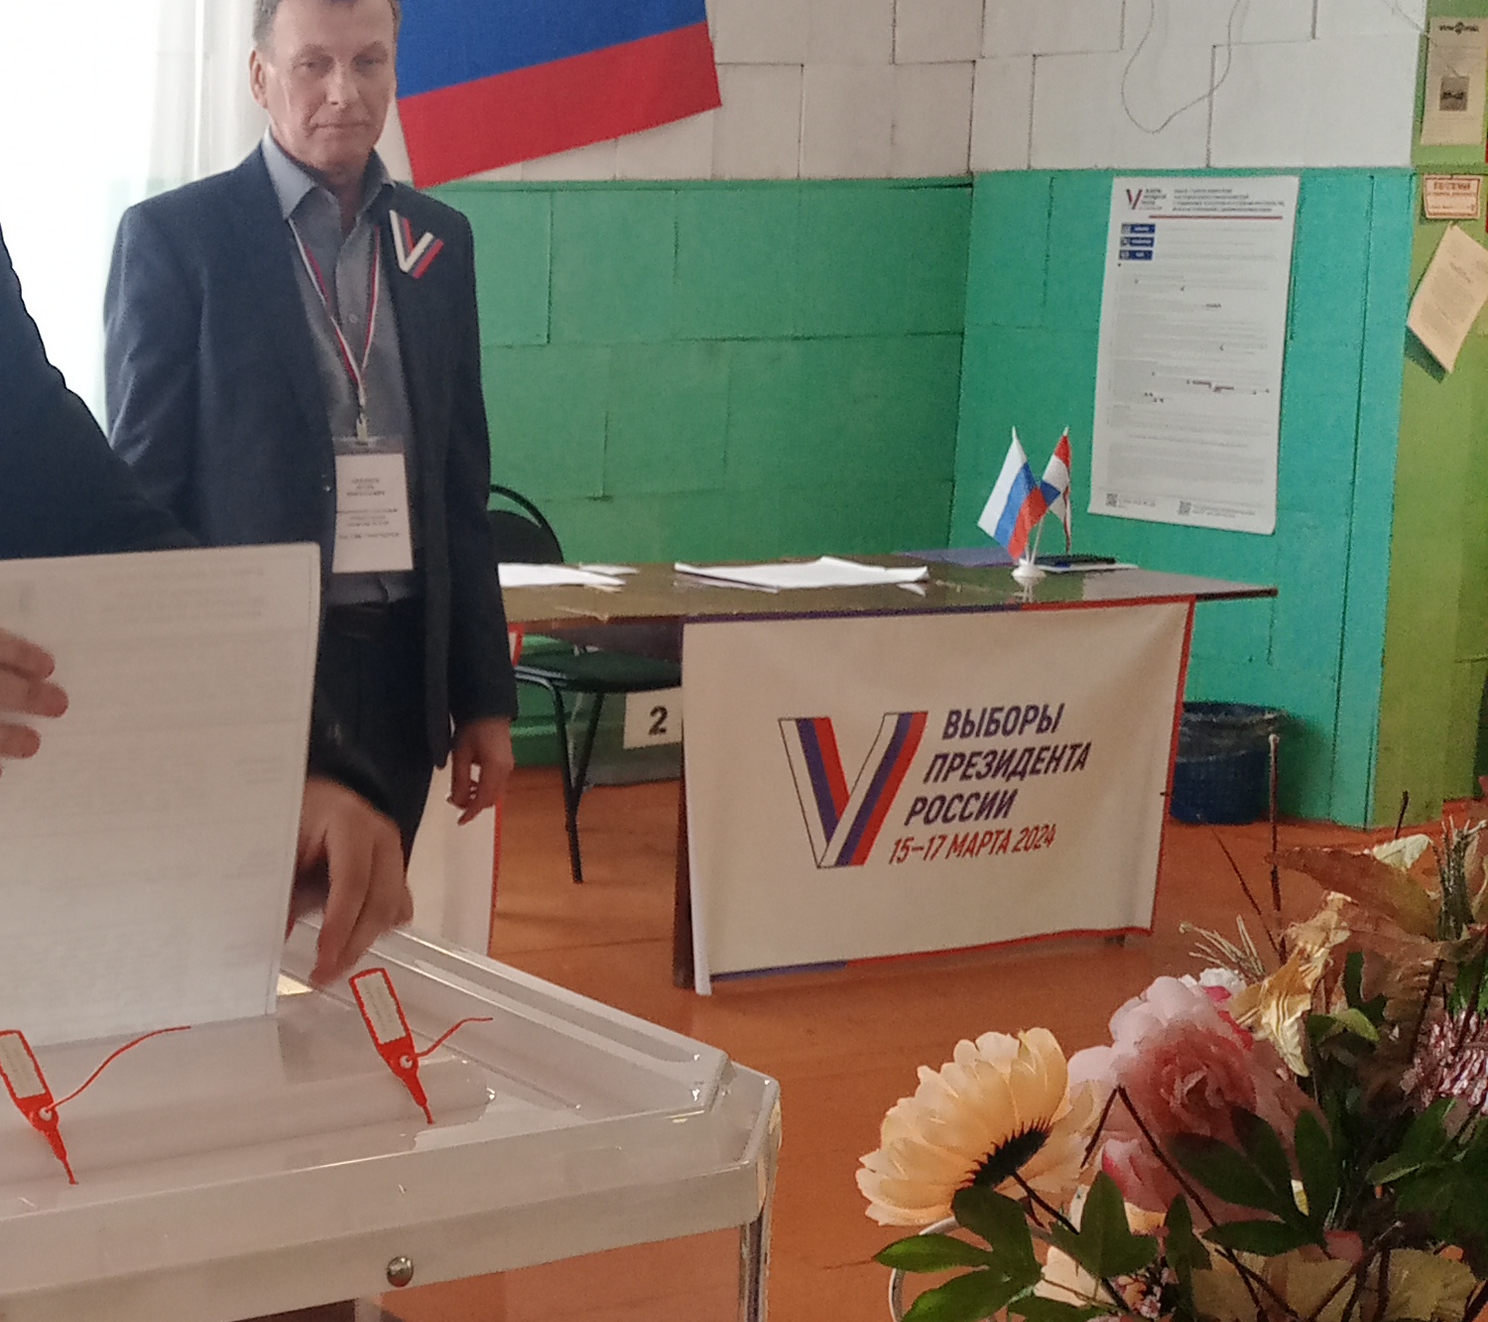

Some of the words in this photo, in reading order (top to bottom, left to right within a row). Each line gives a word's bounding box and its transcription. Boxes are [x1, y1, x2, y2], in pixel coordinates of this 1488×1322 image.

[648, 705, 669, 736] 2
[941, 703, 1066, 741] ВЫБОРЫ
[922, 740, 1093, 785] ПРЕЗИДЕНТА
[903, 788, 1019, 827] РОССИИ
[946, 829, 1012, 859] МАРТА
[1011, 823, 1057, 853] 2024
